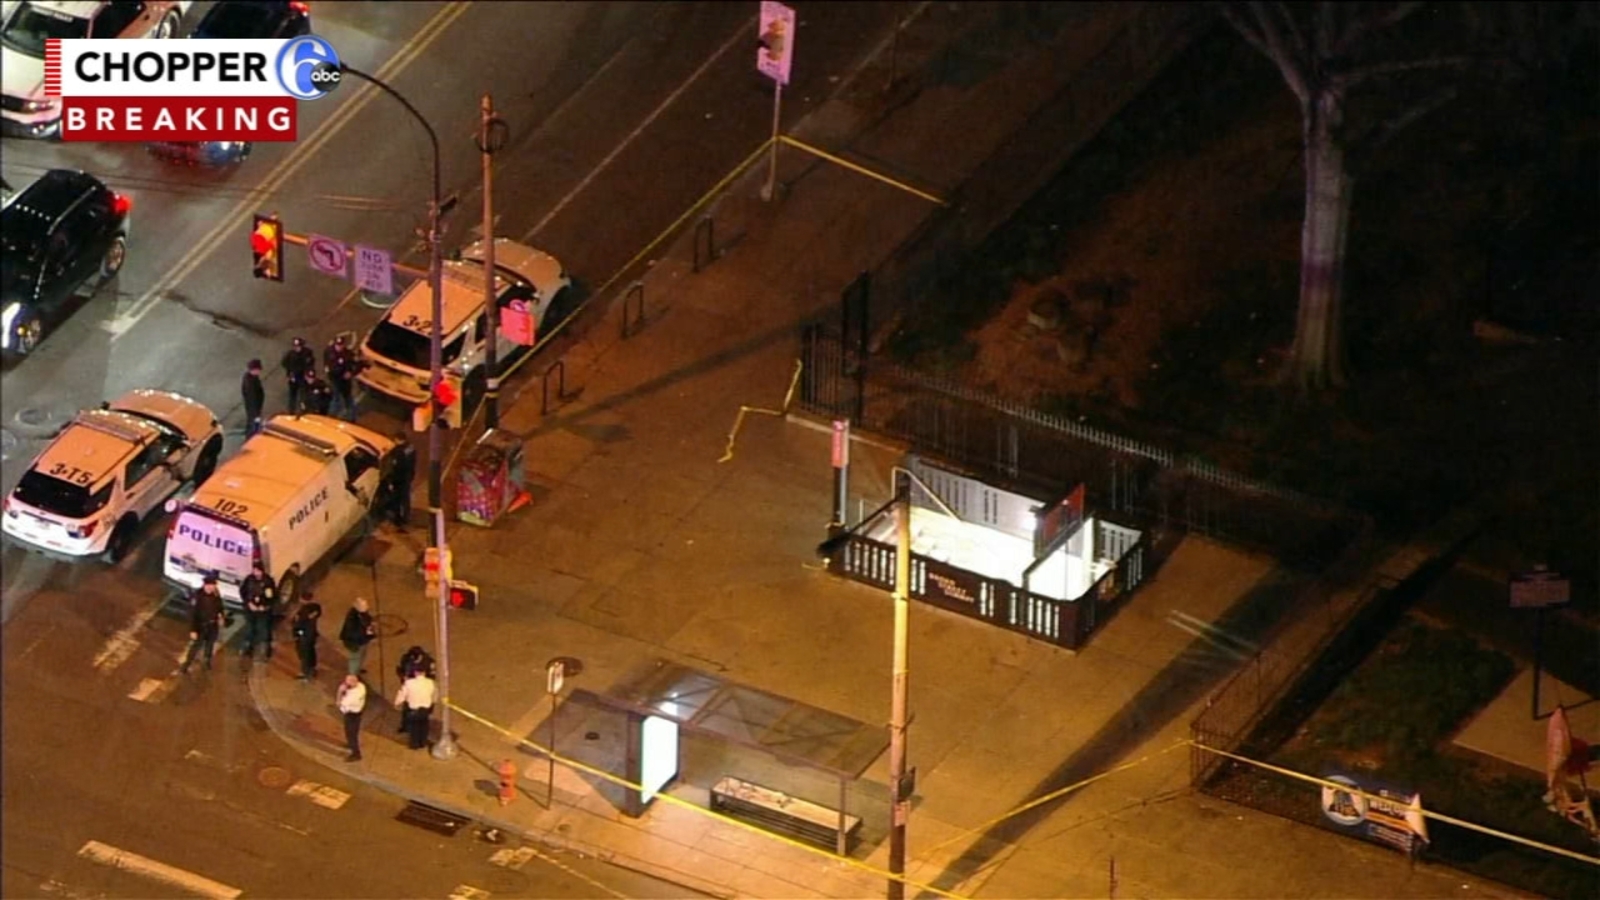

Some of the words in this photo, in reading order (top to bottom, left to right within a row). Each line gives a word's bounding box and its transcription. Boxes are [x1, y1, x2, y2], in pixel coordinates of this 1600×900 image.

[213, 499, 248, 516] 102
[288, 487, 329, 530] POLICE
[179, 524, 249, 557] POLICE
